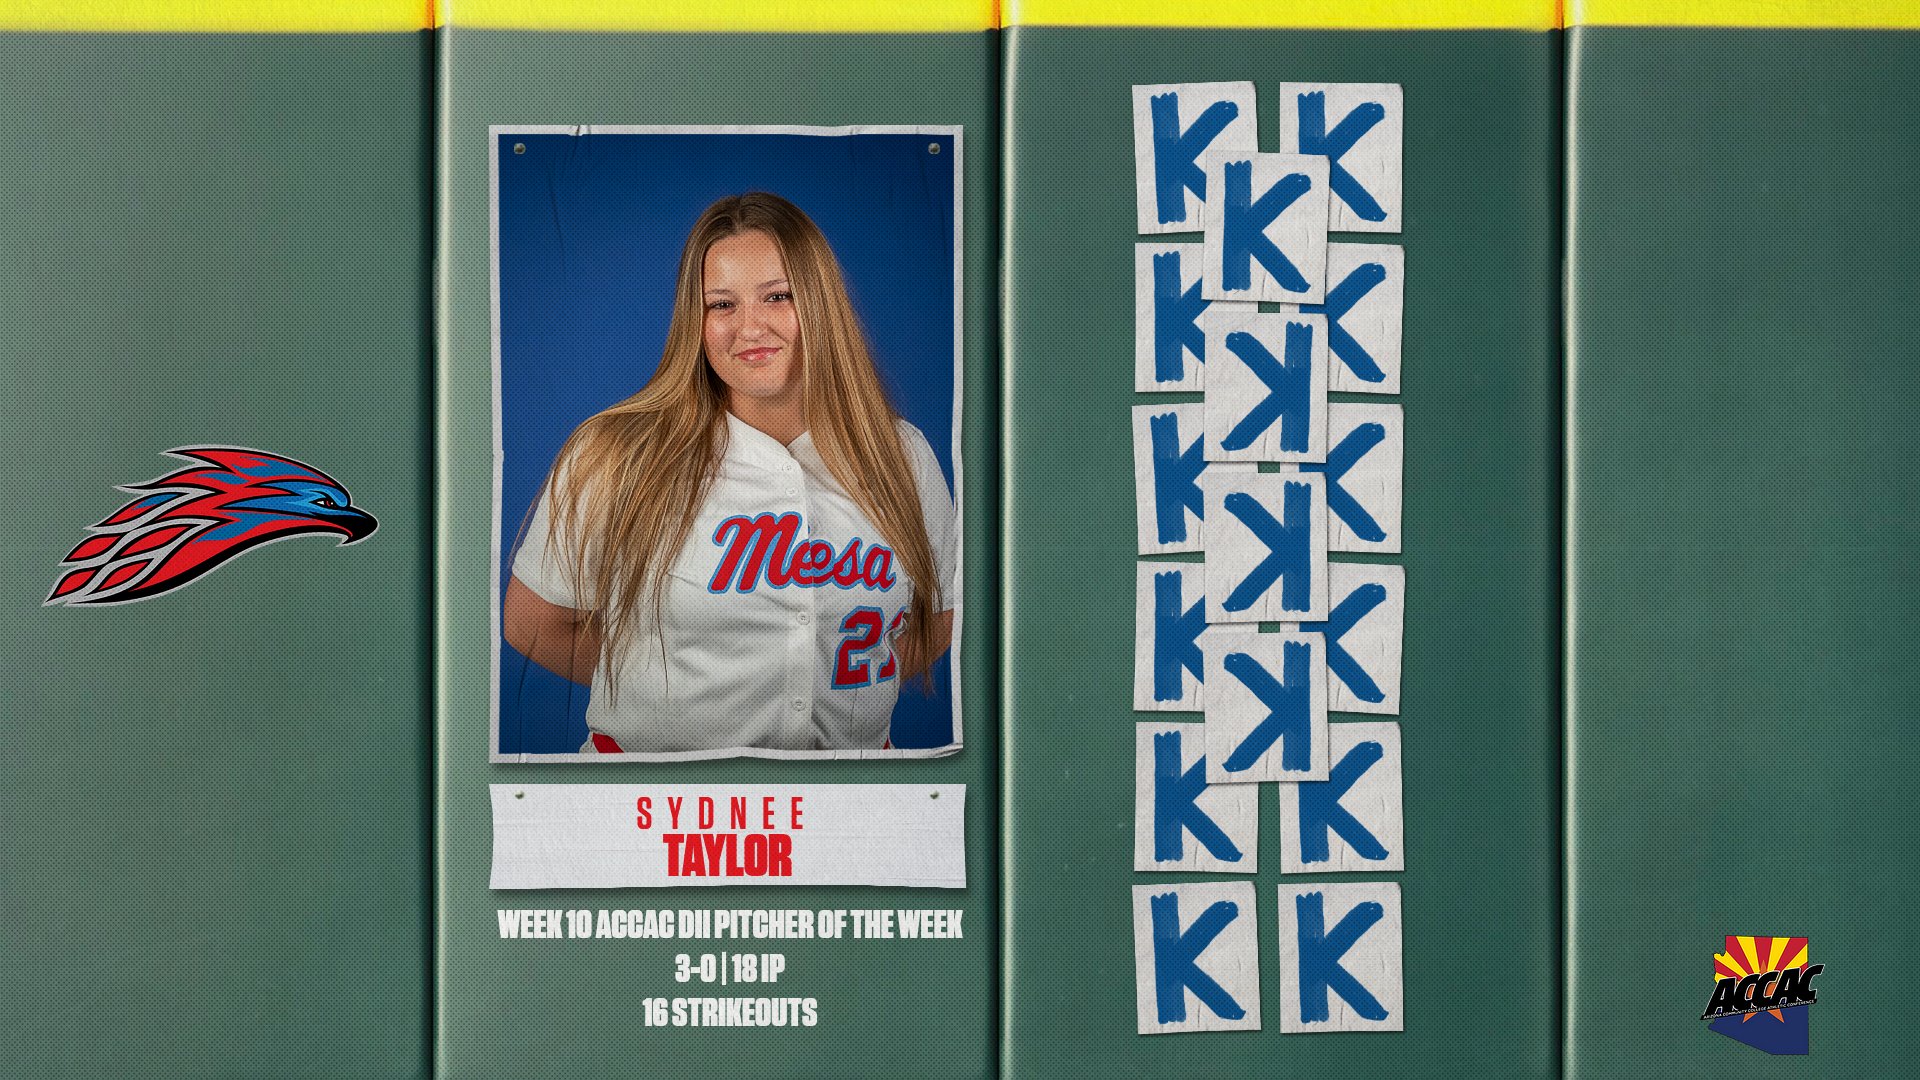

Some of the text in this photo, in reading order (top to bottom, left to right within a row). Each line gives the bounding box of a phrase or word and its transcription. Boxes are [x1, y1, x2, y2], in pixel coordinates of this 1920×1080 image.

[1150, 91, 1239, 225] K
[1297, 90, 1387, 223] K
[1222, 160, 1312, 293] K
[707, 511, 896, 594] Mesa
[636, 796, 804, 830] SYDNEE
[662, 833, 793, 877] TAYLOR
[1153, 731, 1243, 863] K
[1298, 741, 1389, 864] K
[1150, 892, 1246, 1024] K
[1296, 891, 1389, 1024] K
